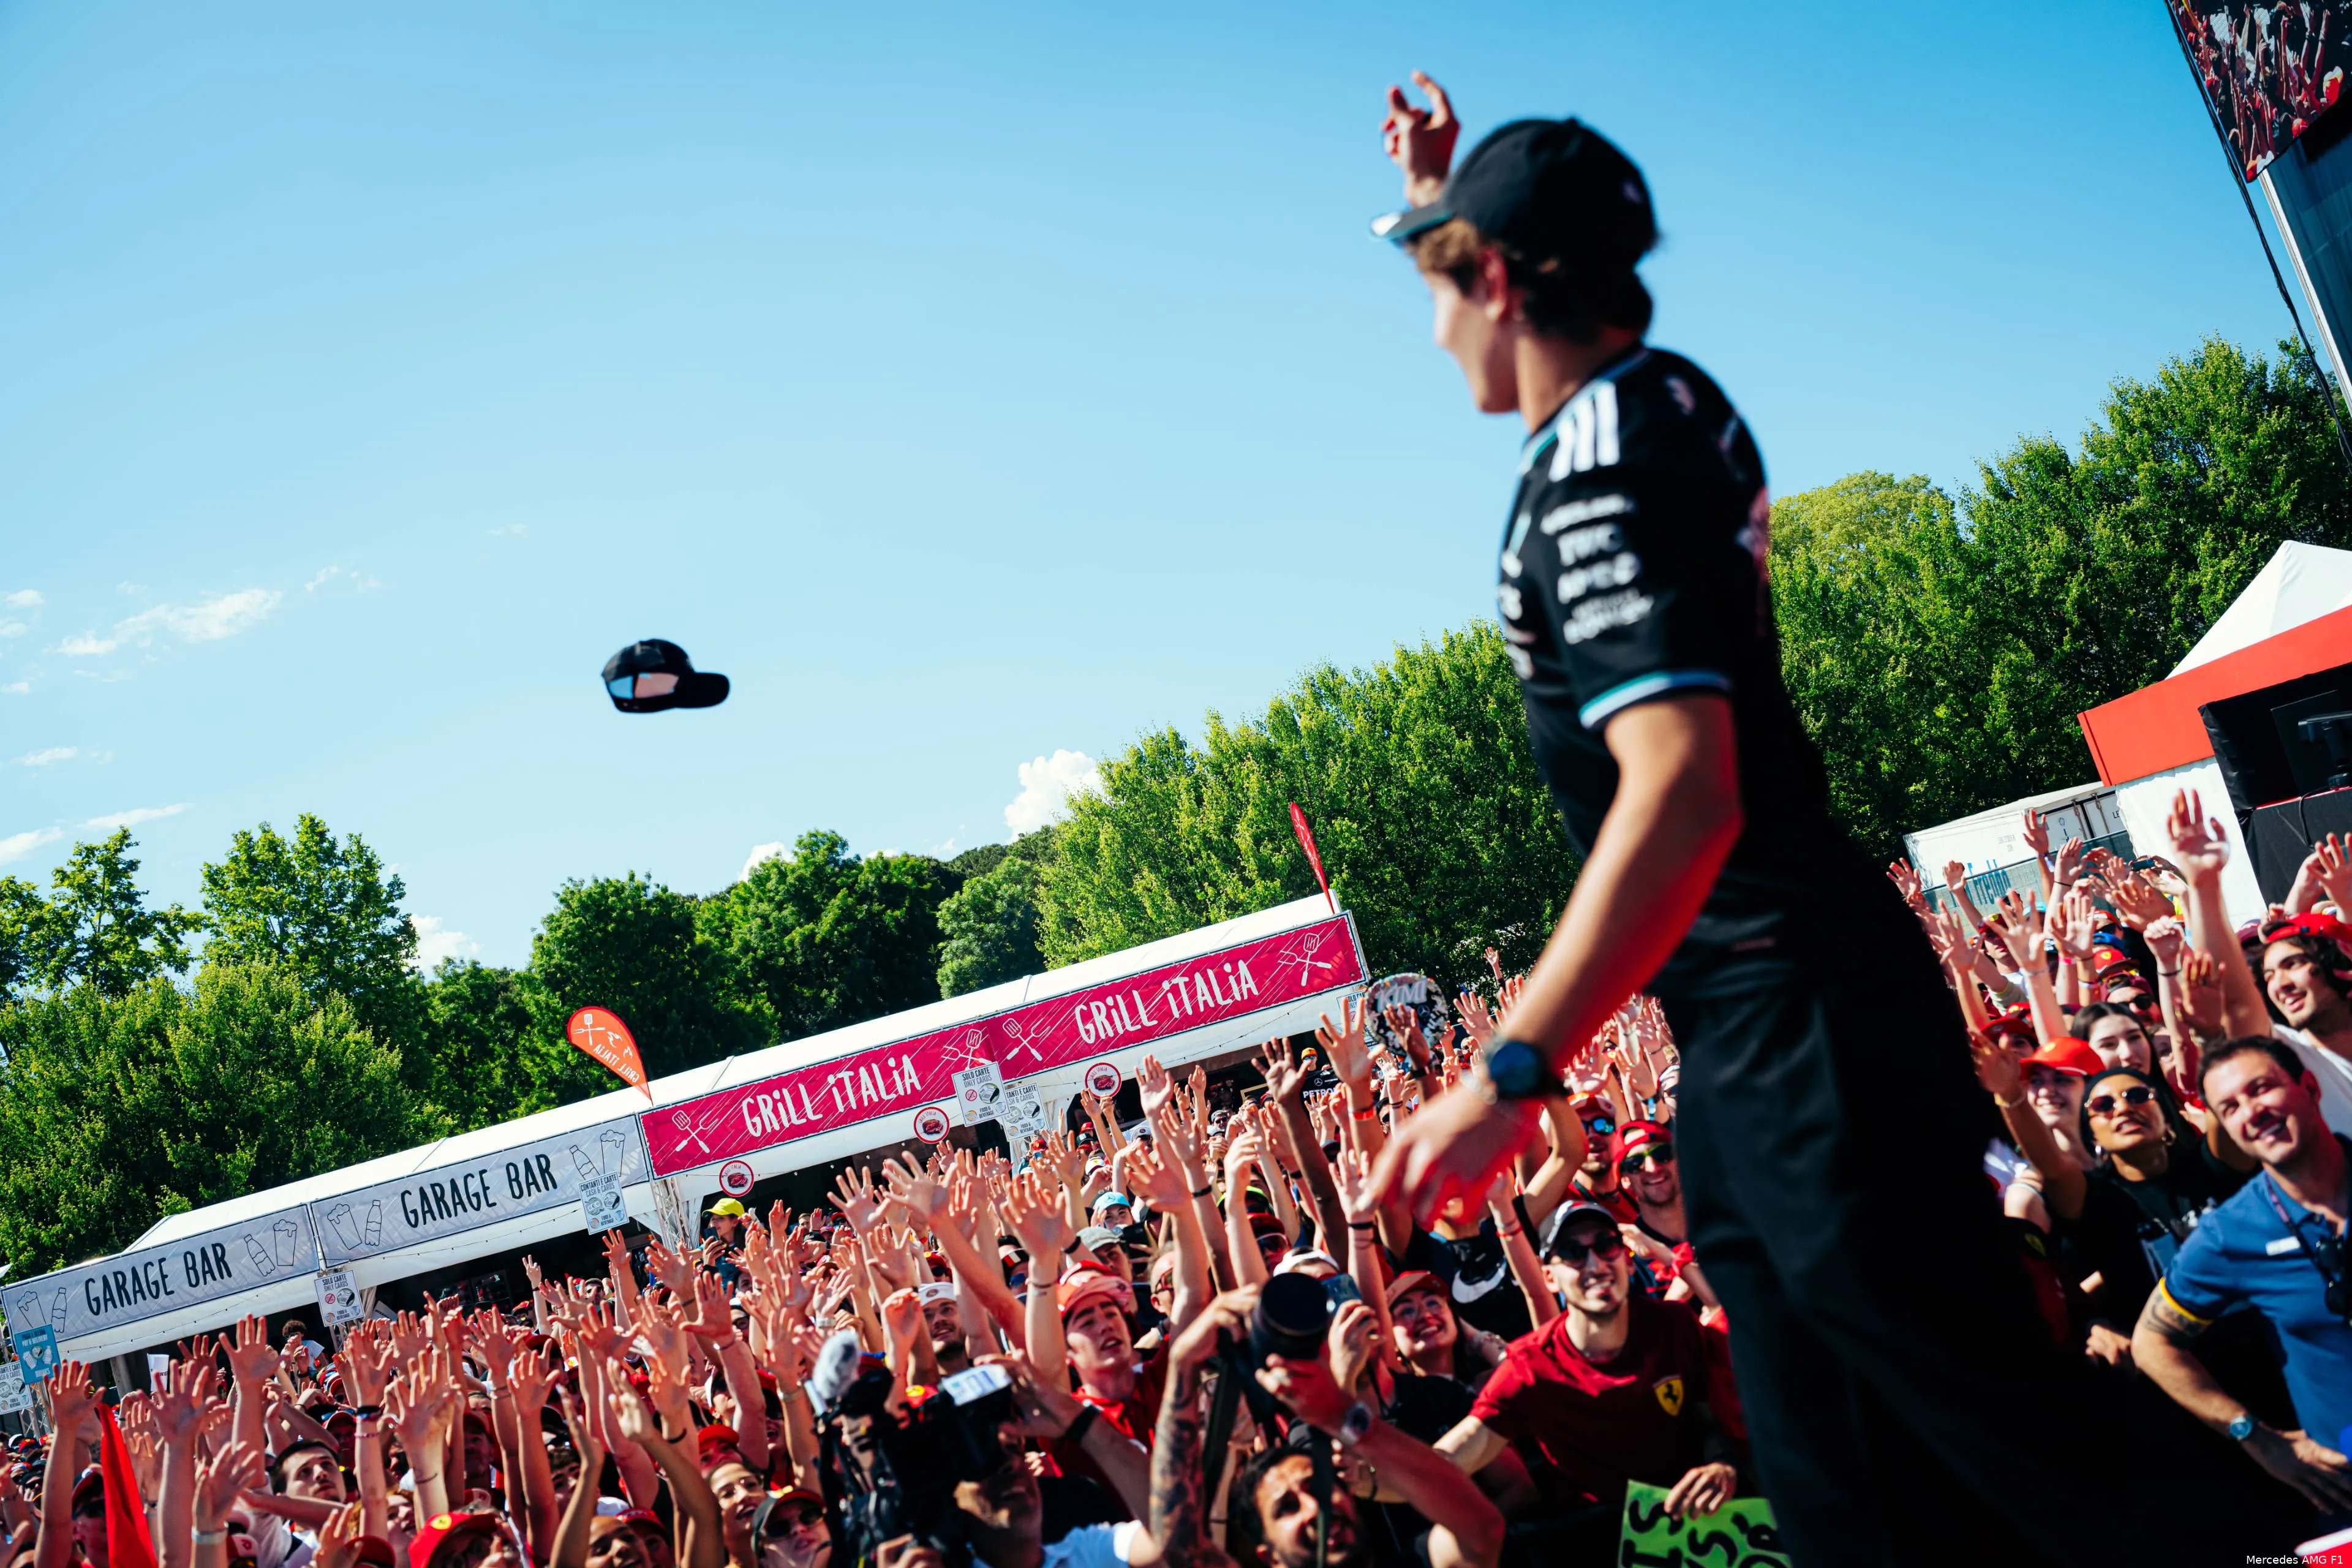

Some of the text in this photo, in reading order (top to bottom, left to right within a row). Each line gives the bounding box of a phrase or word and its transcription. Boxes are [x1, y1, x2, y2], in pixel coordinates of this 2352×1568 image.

[1348, 994, 1356, 1003] OLO
[1376, 980, 1428, 1012] KIMI
[962, 1067, 990, 1081] SOLO CARTE
[964, 1074, 992, 1088] ONLY CARDS
[1006, 1090, 1019, 1099] TANTI
[1022, 1085, 1036, 1095] CARTE
[1020, 1093, 1035, 1101] CARDS
[581, 1179, 600, 1191] CONTANTI
[604, 1174, 617, 1183] CARTE
[401, 1154, 557, 1228] GARAGE BAR
[586, 1189, 597, 1197] CASH
[601, 1183, 615, 1193] CARDS
[85, 1243, 232, 1316] GARAGE BAR
[322, 1274, 347, 1286] SOLO CARTE
[335, 1280, 349, 1289] CARDS
